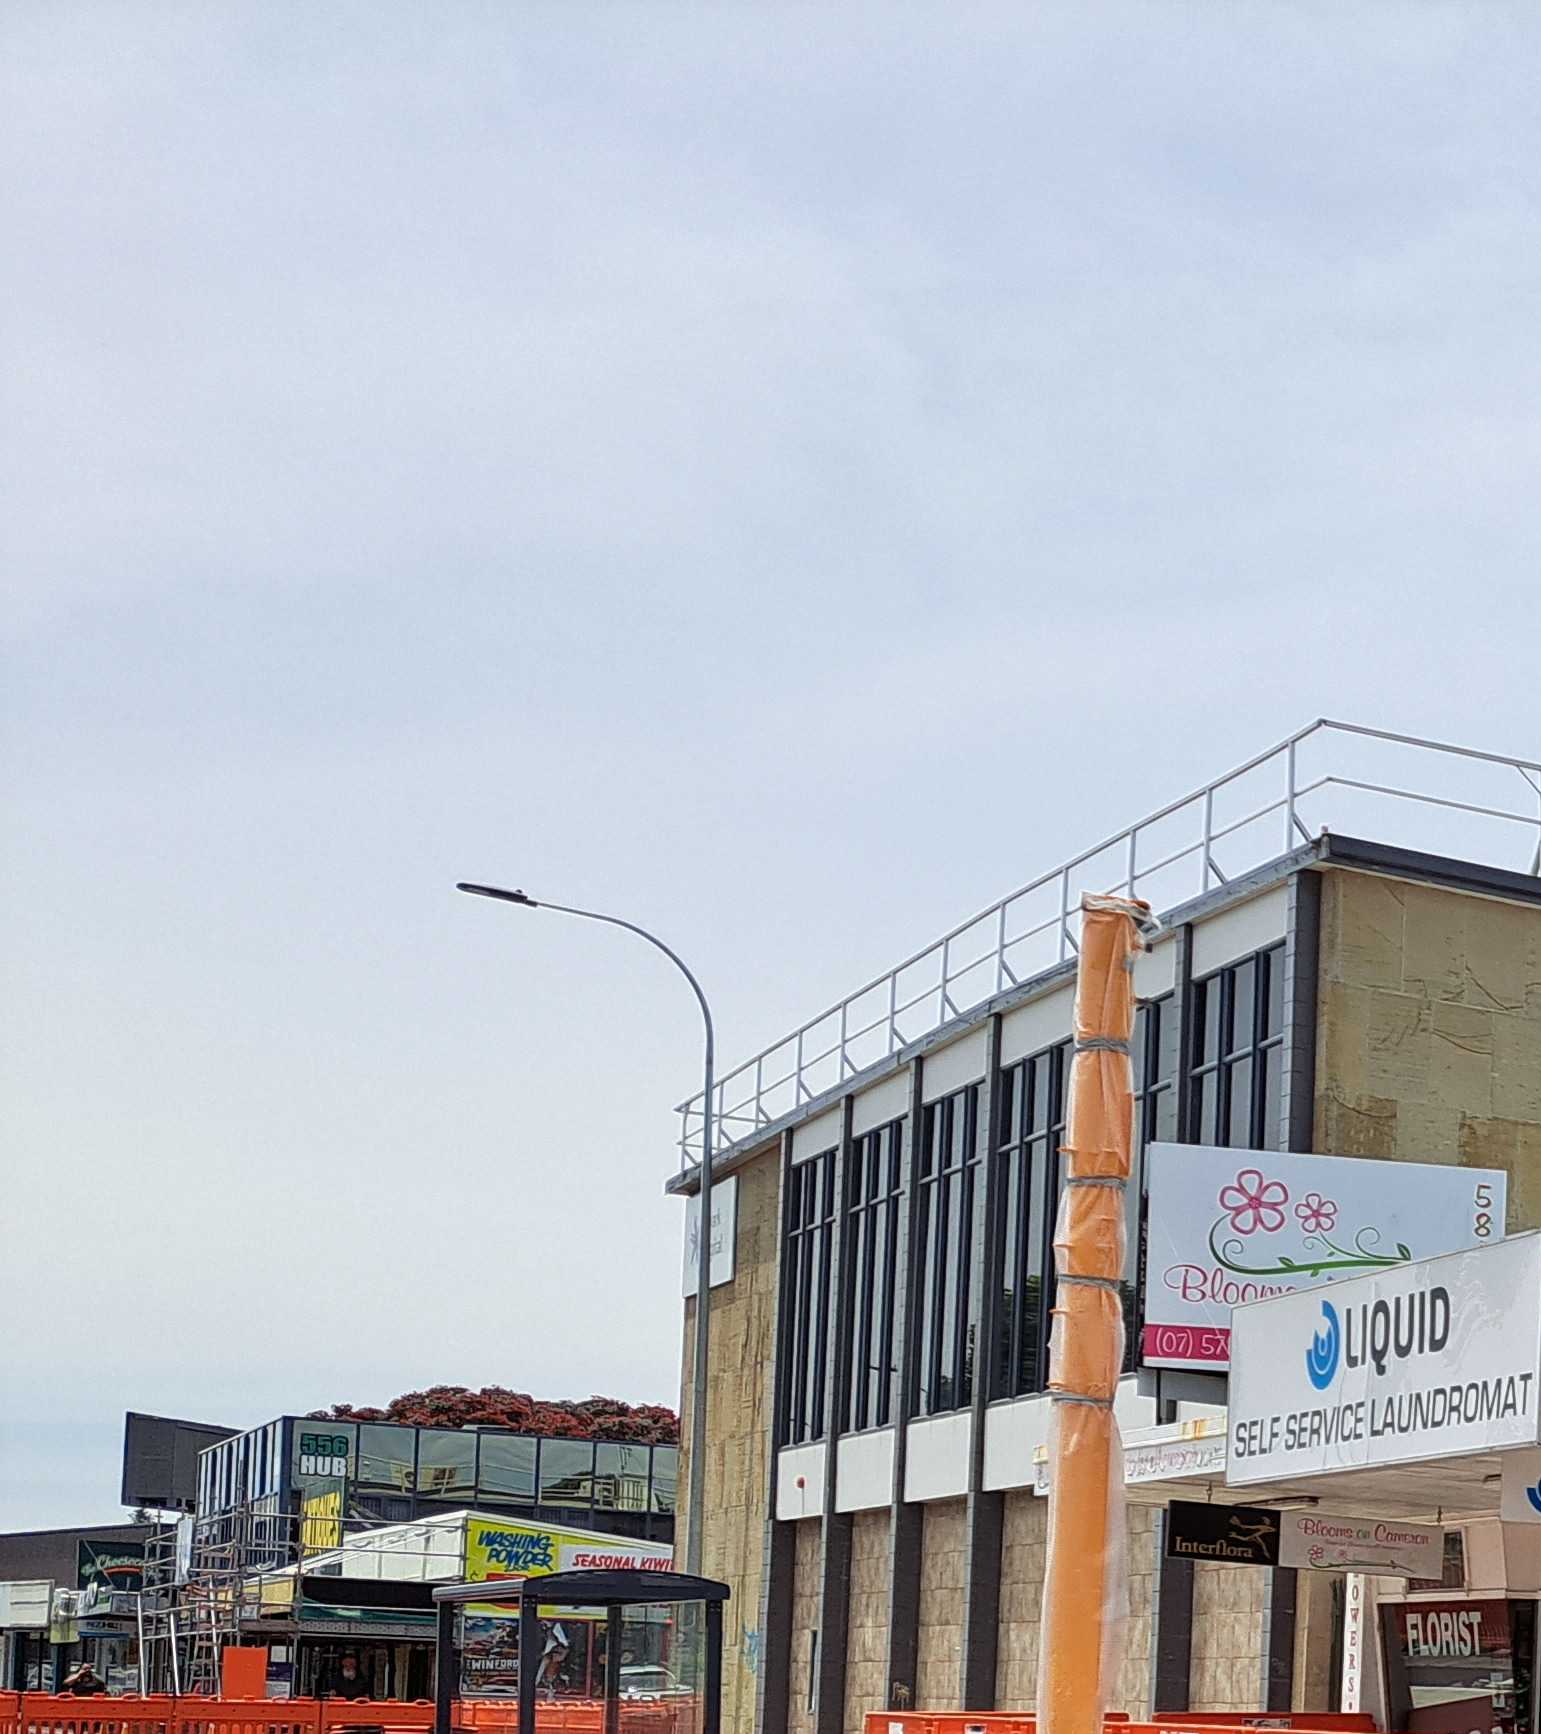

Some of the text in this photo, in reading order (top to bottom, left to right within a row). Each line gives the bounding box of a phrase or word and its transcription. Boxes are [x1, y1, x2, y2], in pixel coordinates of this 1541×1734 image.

[1155, 1328, 1193, 1356] (07)
[1346, 1287, 1450, 1376] LIQUID
[1235, 1373, 1533, 1459] SELF SERVICE LAUNDROMAT
[301, 1433, 348, 1457] 556
[300, 1454, 347, 1477] HUB
[1297, 1518, 1353, 1538] Blooms
[1374, 1524, 1429, 1546] Cameron
[1175, 1536, 1253, 1558] Interflora
[573, 1554, 636, 1569] SEASONAL
[1406, 1611, 1484, 1657] FLORIST
